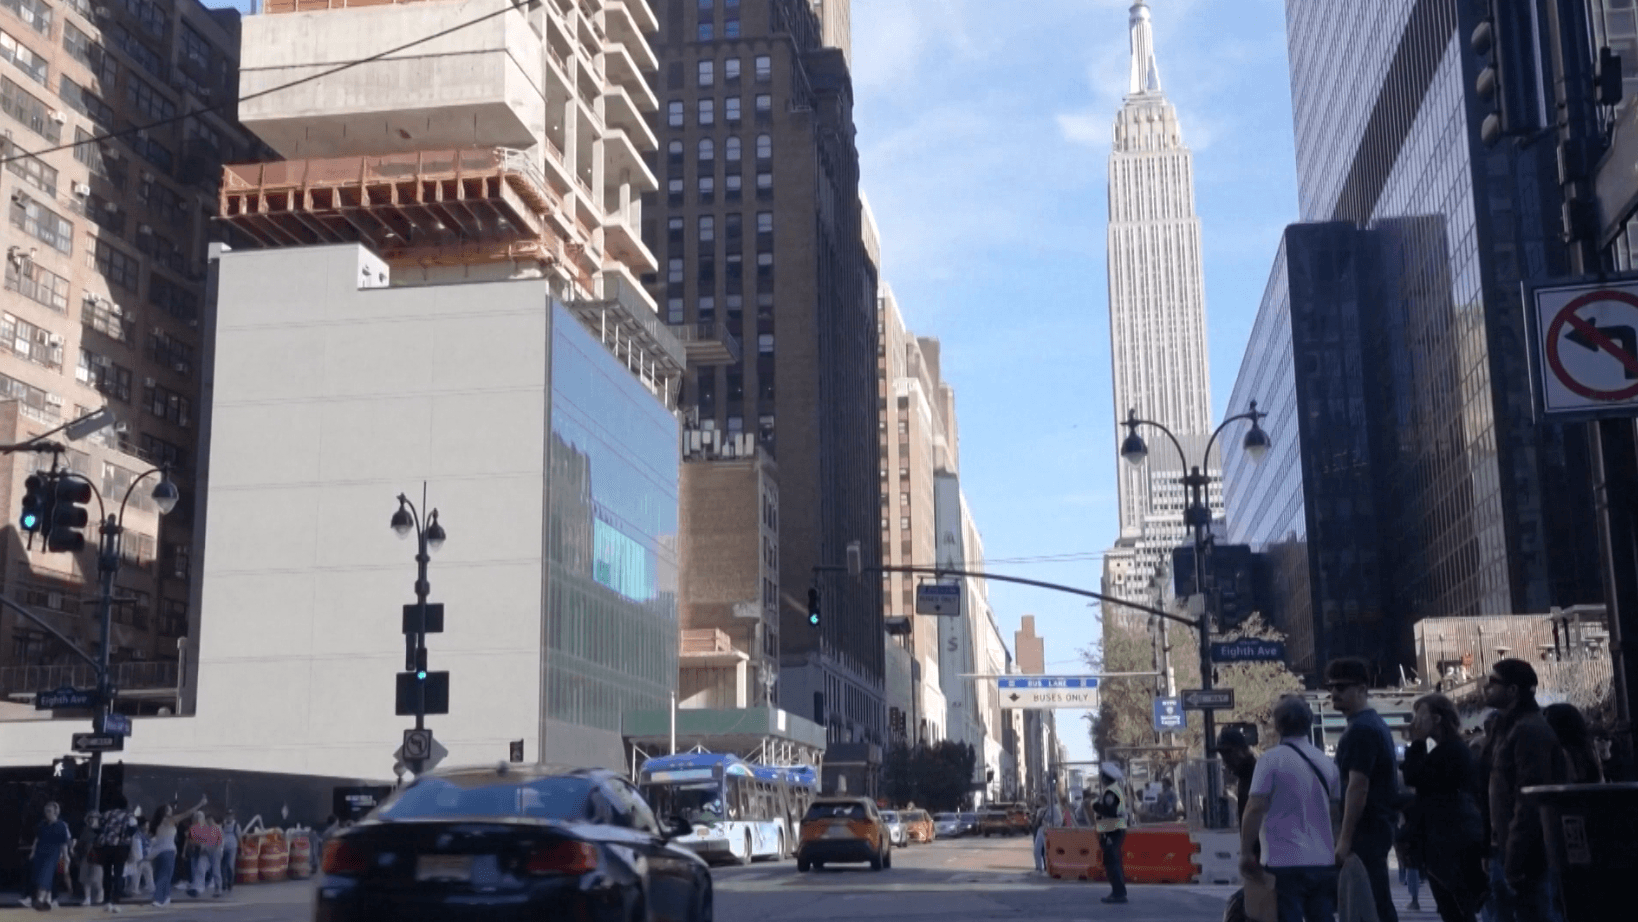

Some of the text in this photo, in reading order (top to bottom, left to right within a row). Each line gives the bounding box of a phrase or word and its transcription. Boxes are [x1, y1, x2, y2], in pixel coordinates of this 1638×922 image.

[1221, 646, 1277, 659] Eighth Ave
[1027, 678, 1067, 688] BUS LANE
[41, 695, 69, 708] Eighth
[1033, 693, 1089, 702] BUSES ONLY
